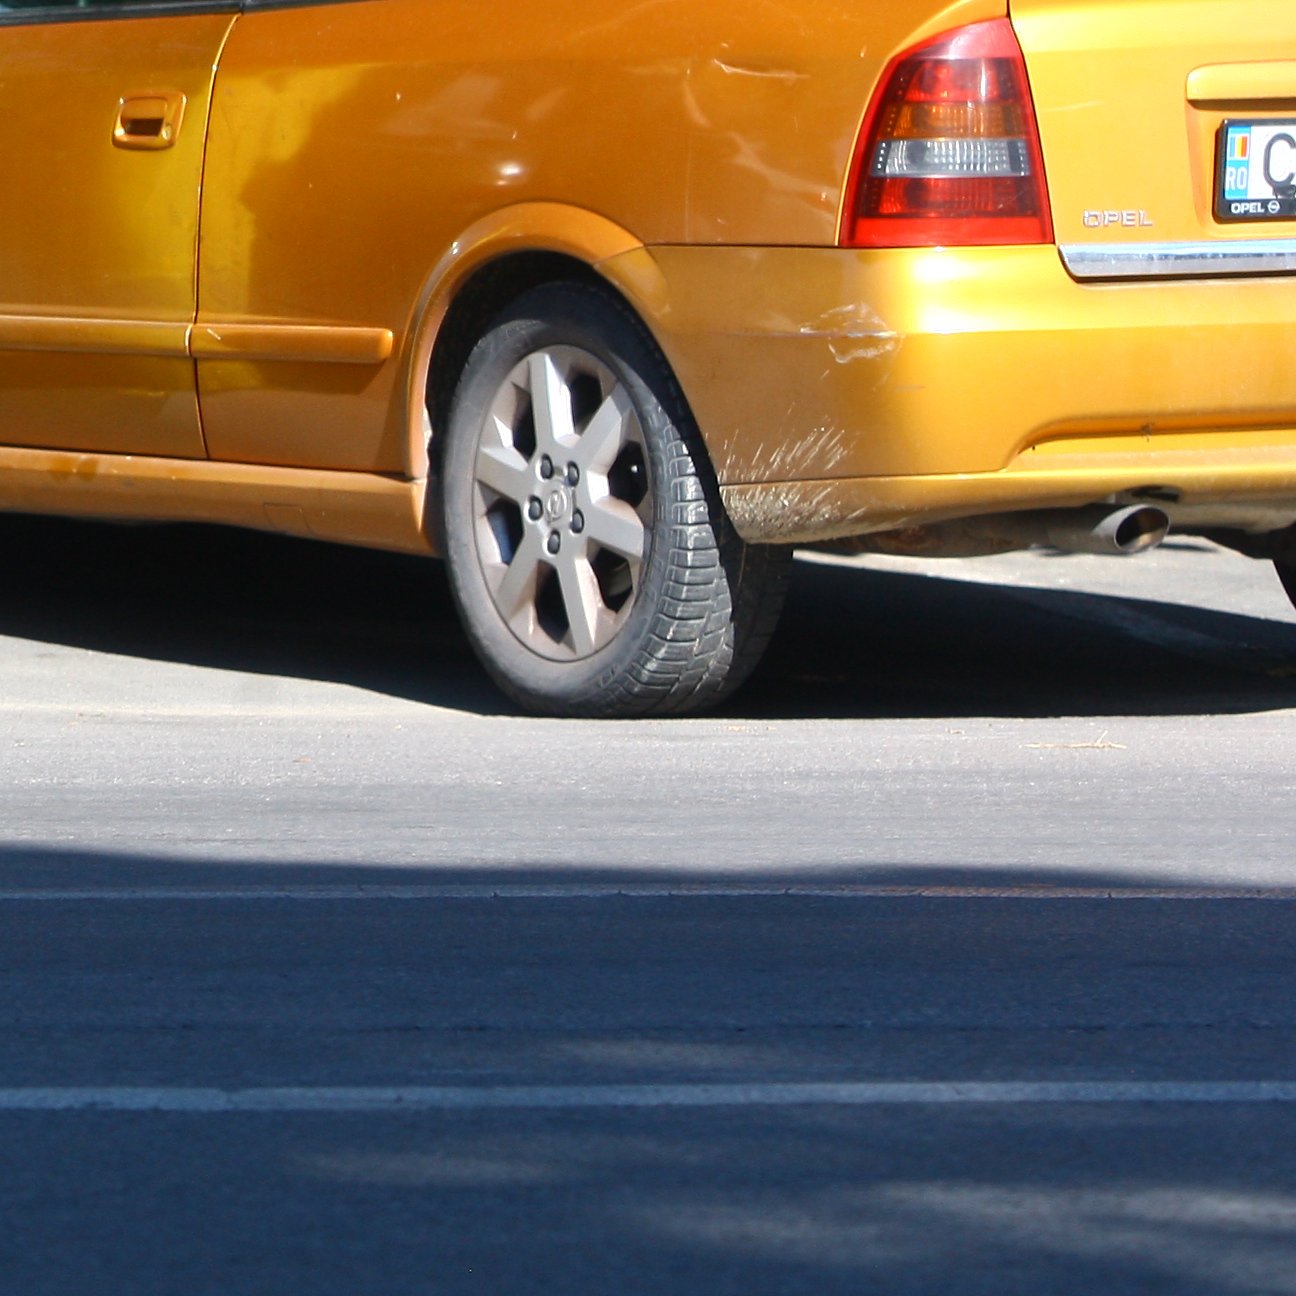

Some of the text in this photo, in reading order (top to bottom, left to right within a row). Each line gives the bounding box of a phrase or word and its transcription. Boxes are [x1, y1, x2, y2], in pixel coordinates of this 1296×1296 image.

[1225, 166, 1248, 191] RO
[1230, 201, 1265, 215] OPEL
[1082, 209, 1154, 228] OPEL
